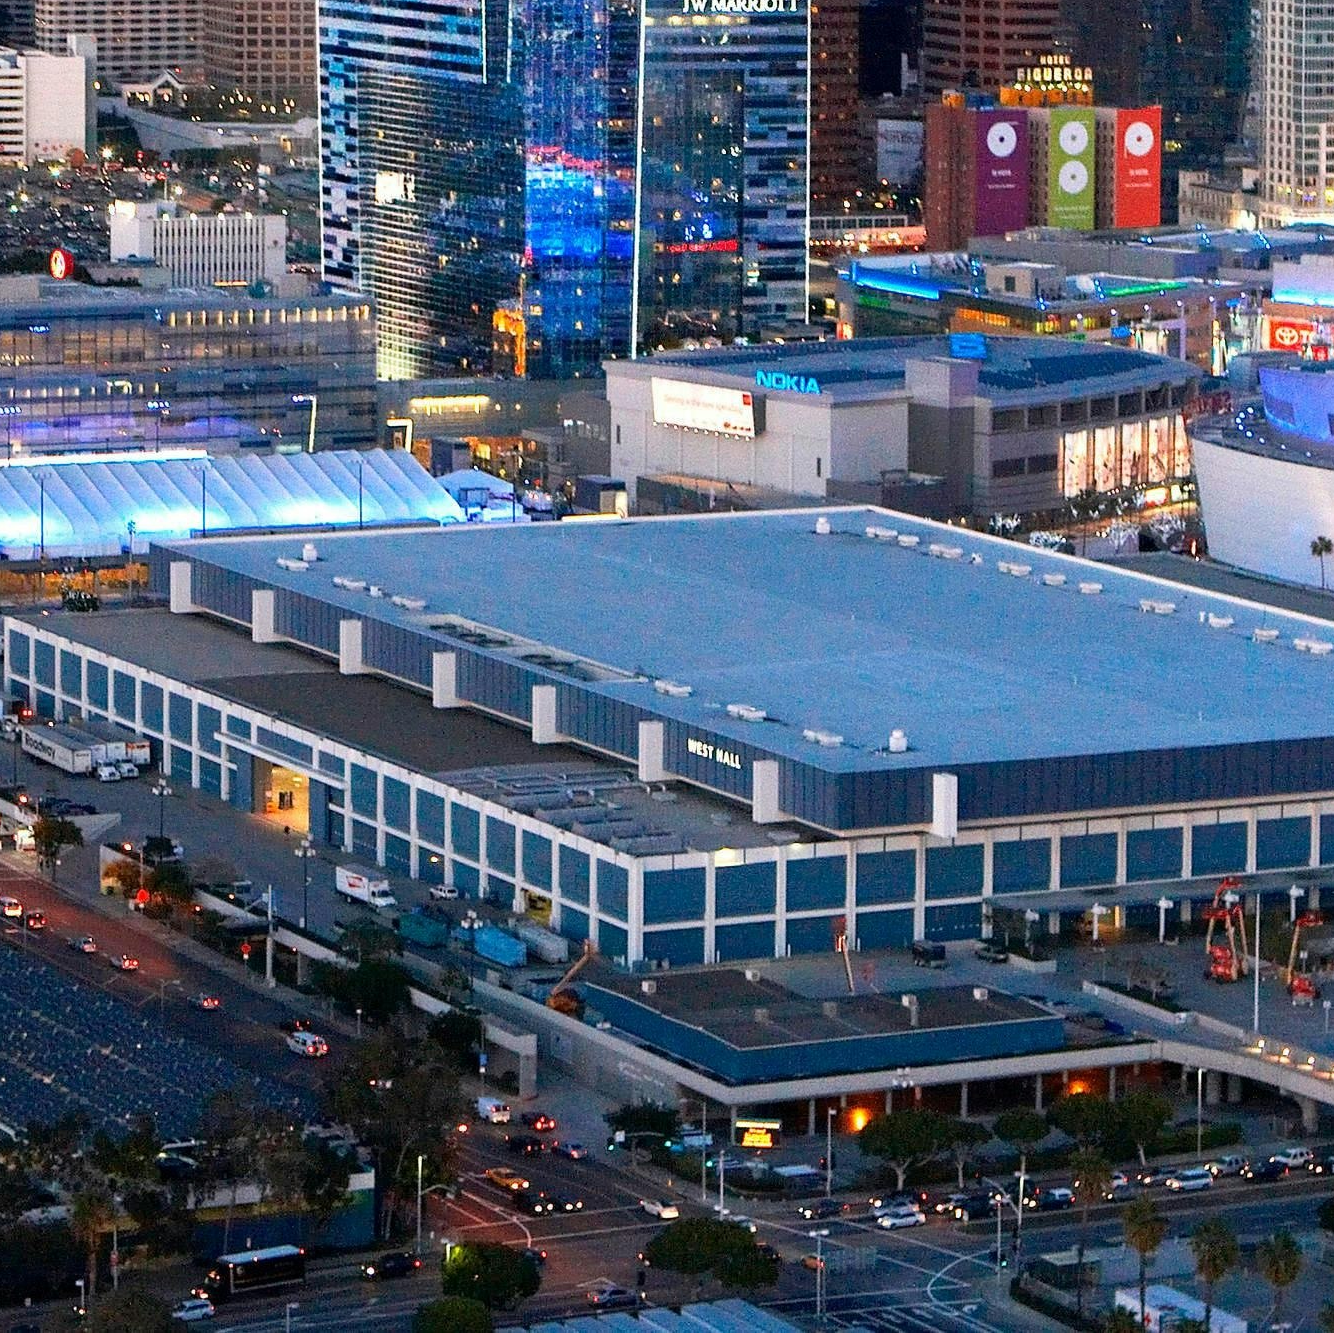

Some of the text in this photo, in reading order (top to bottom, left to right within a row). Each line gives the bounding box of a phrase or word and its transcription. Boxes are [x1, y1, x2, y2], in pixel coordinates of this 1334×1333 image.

[1039, 54, 1072, 66] HOTEL
[1016, 66, 1094, 83] FIGUEROA
[755, 369, 822, 395] NOKIA
[687, 737, 742, 770] WEST HALL
